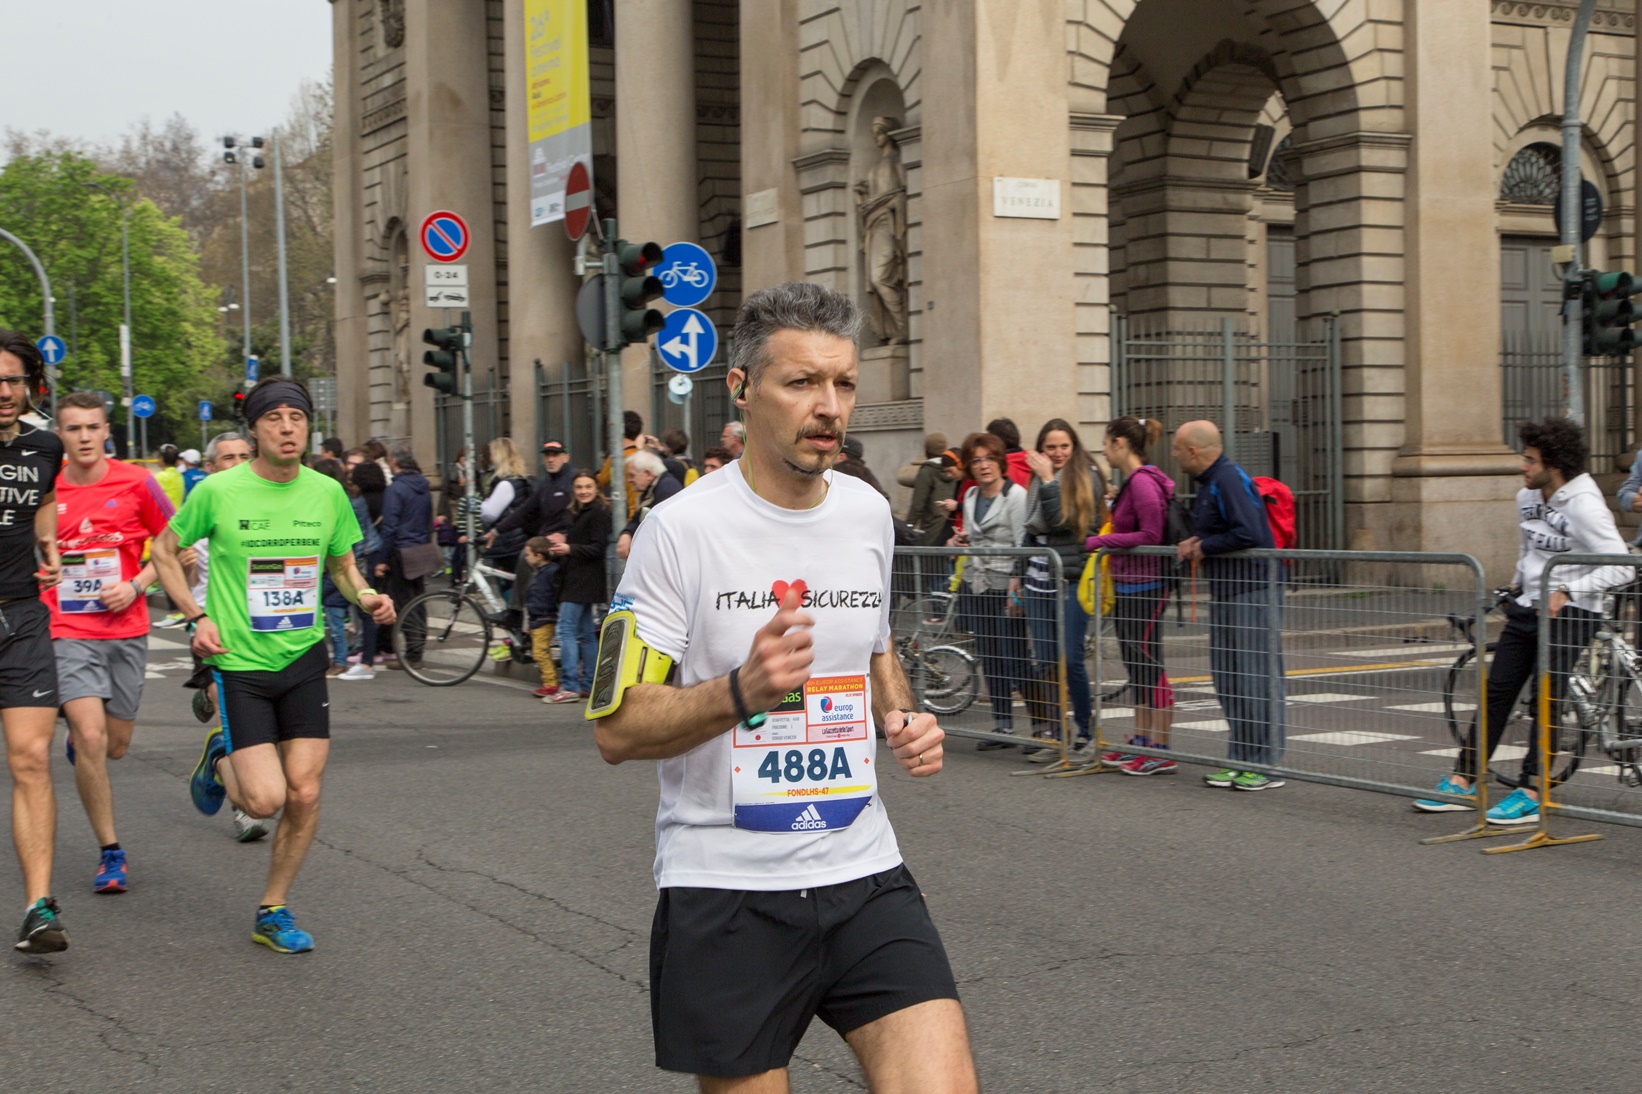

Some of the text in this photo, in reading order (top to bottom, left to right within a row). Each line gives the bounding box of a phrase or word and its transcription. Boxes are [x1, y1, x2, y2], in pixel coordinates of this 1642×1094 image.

[1001, 196, 1054, 207] VENEZIA
[0, 464, 39, 482] GIN
[263, 590, 304, 607] 138A
[716, 590, 781, 611] ITALIA
[807, 683, 863, 693] RELAY MARATHON
[834, 704, 853, 712] europ
[821, 713, 854, 722] assistance
[757, 746, 852, 784] 488A
[787, 787, 829, 797] FONDLHS-47
[791, 820, 827, 831] adidas
